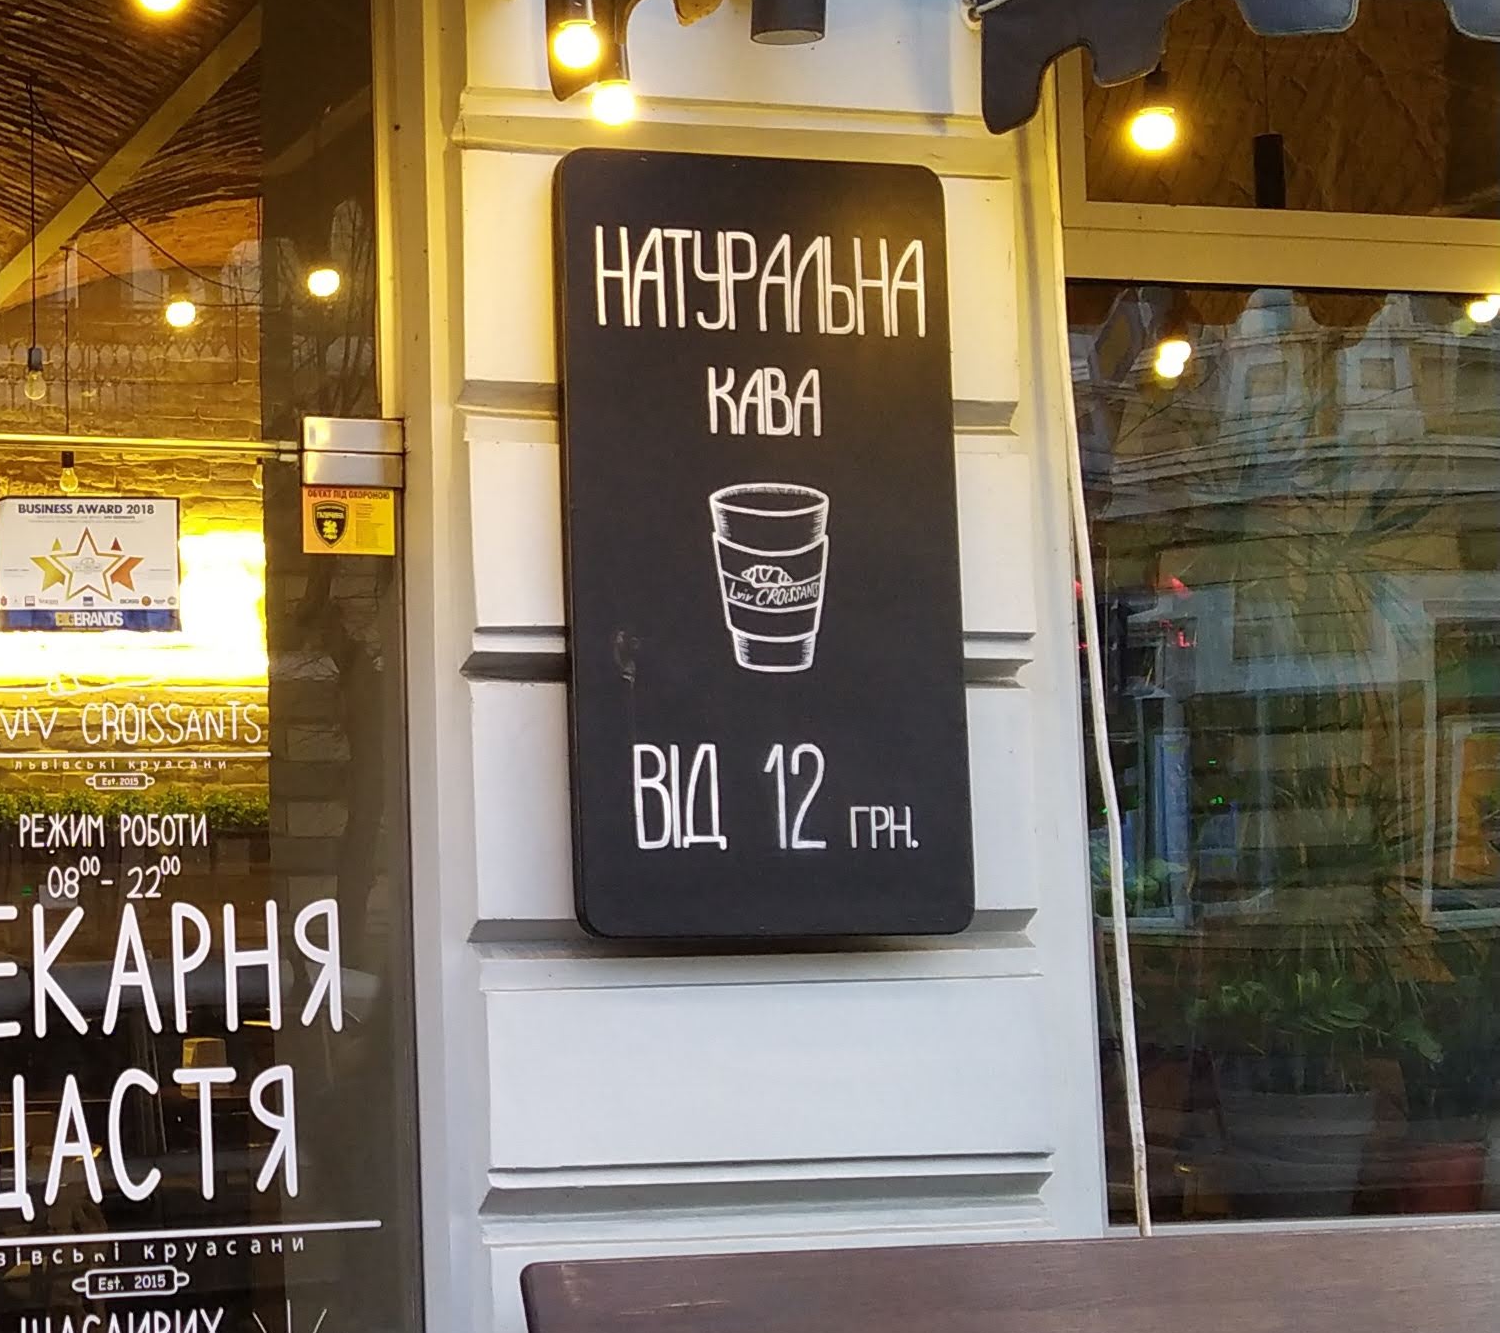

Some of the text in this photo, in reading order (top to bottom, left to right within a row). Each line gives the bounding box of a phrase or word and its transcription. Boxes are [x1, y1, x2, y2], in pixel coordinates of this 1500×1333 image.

[595, 225, 926, 338] НАТУРАЛЬНА
[707, 366, 822, 437] КАВА
[18, 503, 155, 515] BUSINESS AWARD 2018
[14, 759, 228, 773] львівські круасани
[119, 777, 140, 786] 2015
[633, 743, 920, 851] ВІД 12 ГРН.
[19, 812, 208, 848] РЕЖИМ РОБОТИ
[143, 1236, 305, 1264] круасани
[97, 1273, 167, 1292] Est. 2015
